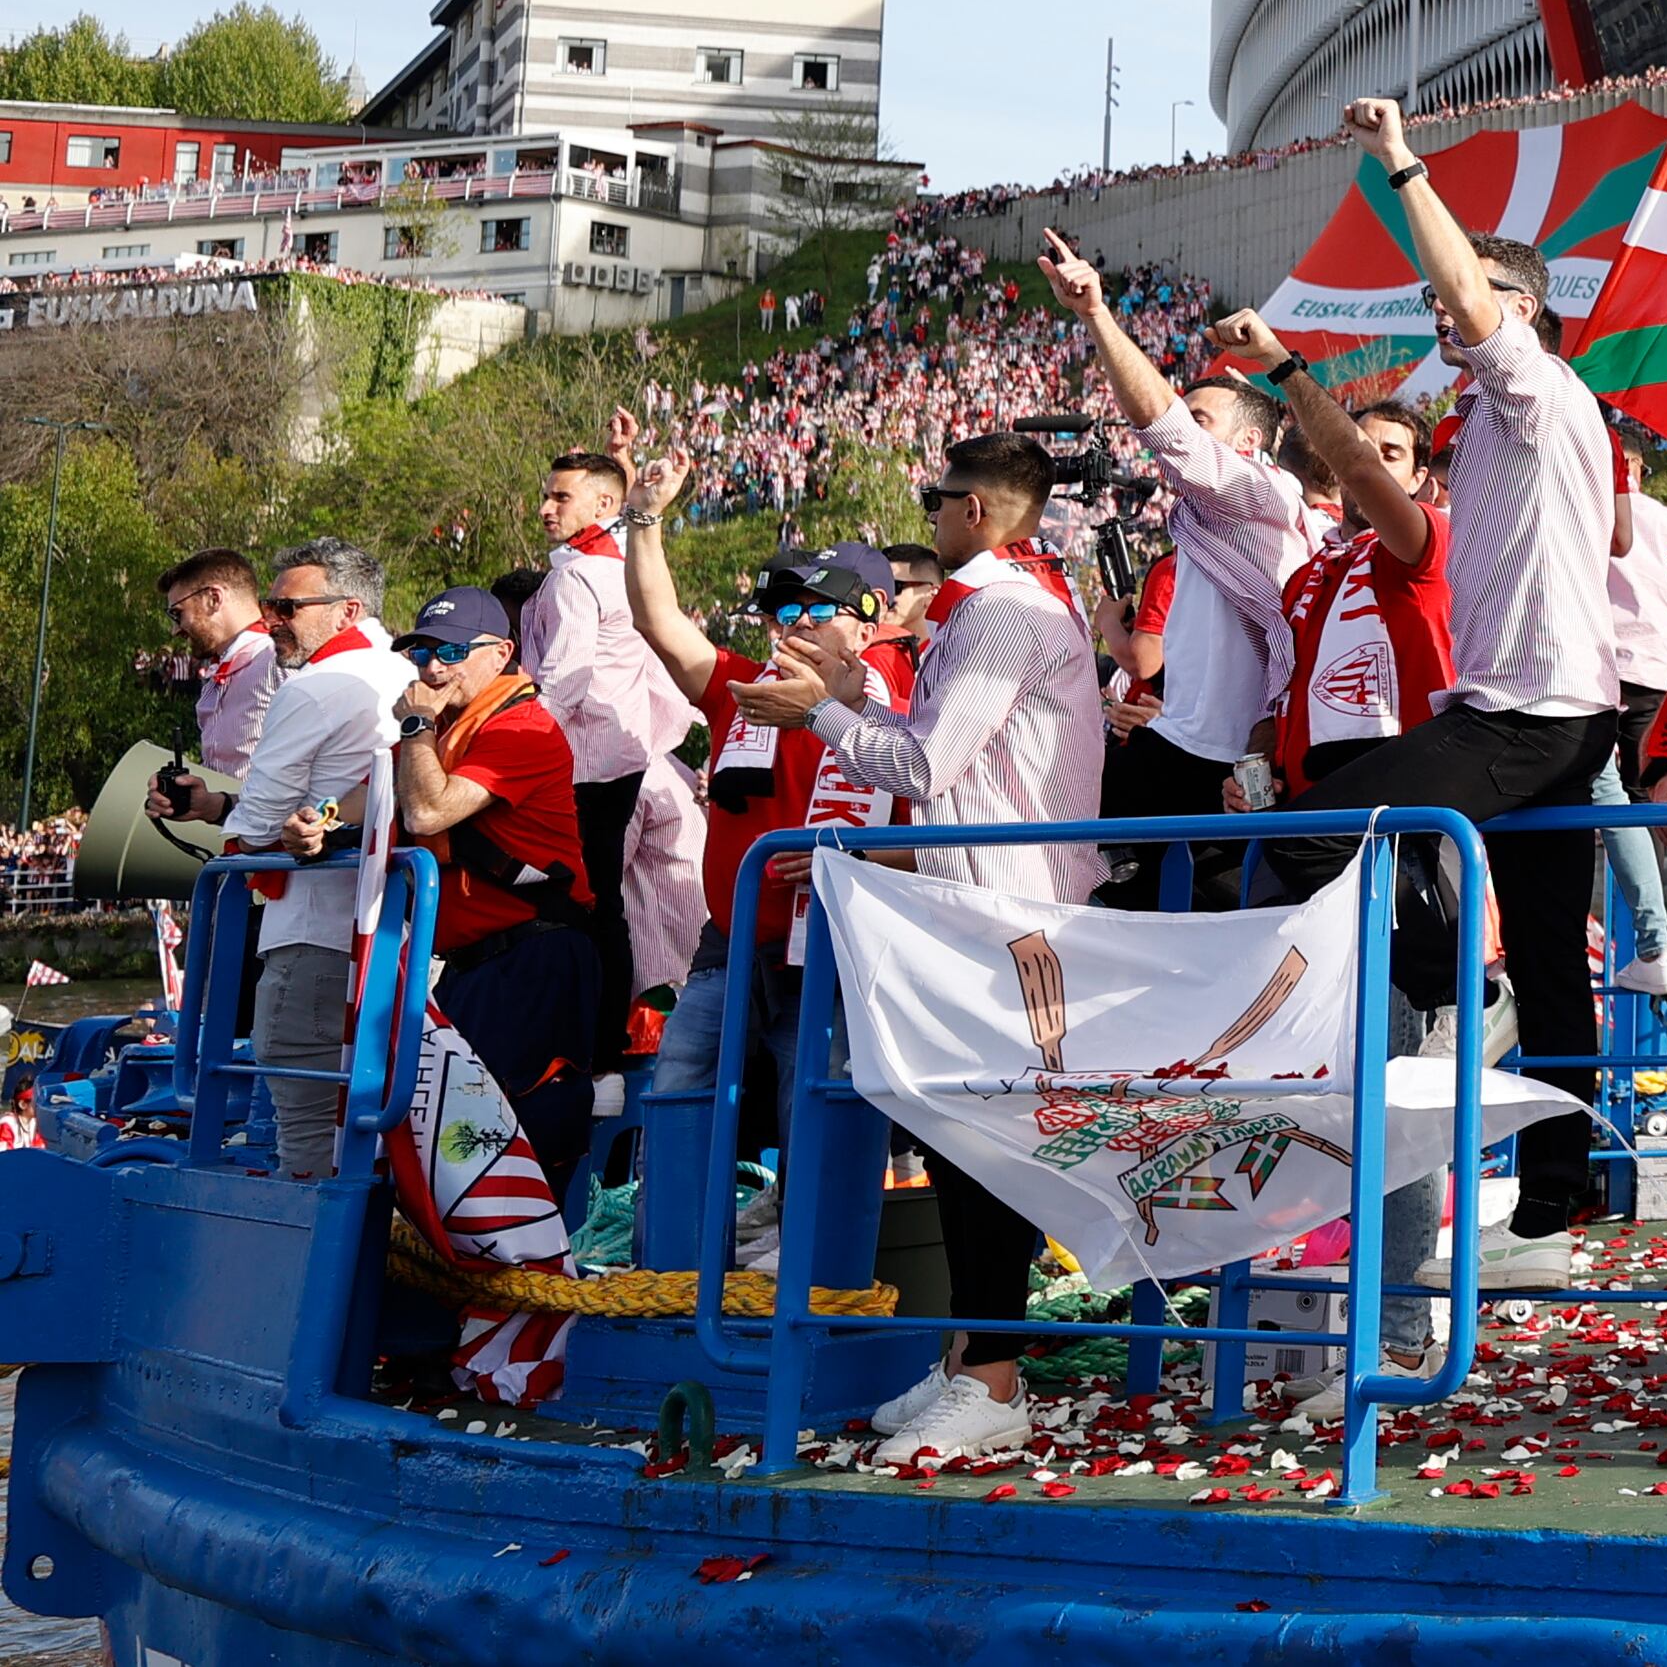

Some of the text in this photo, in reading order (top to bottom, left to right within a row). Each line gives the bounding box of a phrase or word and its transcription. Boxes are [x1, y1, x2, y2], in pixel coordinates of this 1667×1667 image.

[27, 280, 258, 328] EUSKALDUNA
[1292, 298, 1358, 319] EUSKAL
[1549, 276, 1599, 300] QUES
[1126, 1117, 1289, 1199] ARRAUN TALDEA
